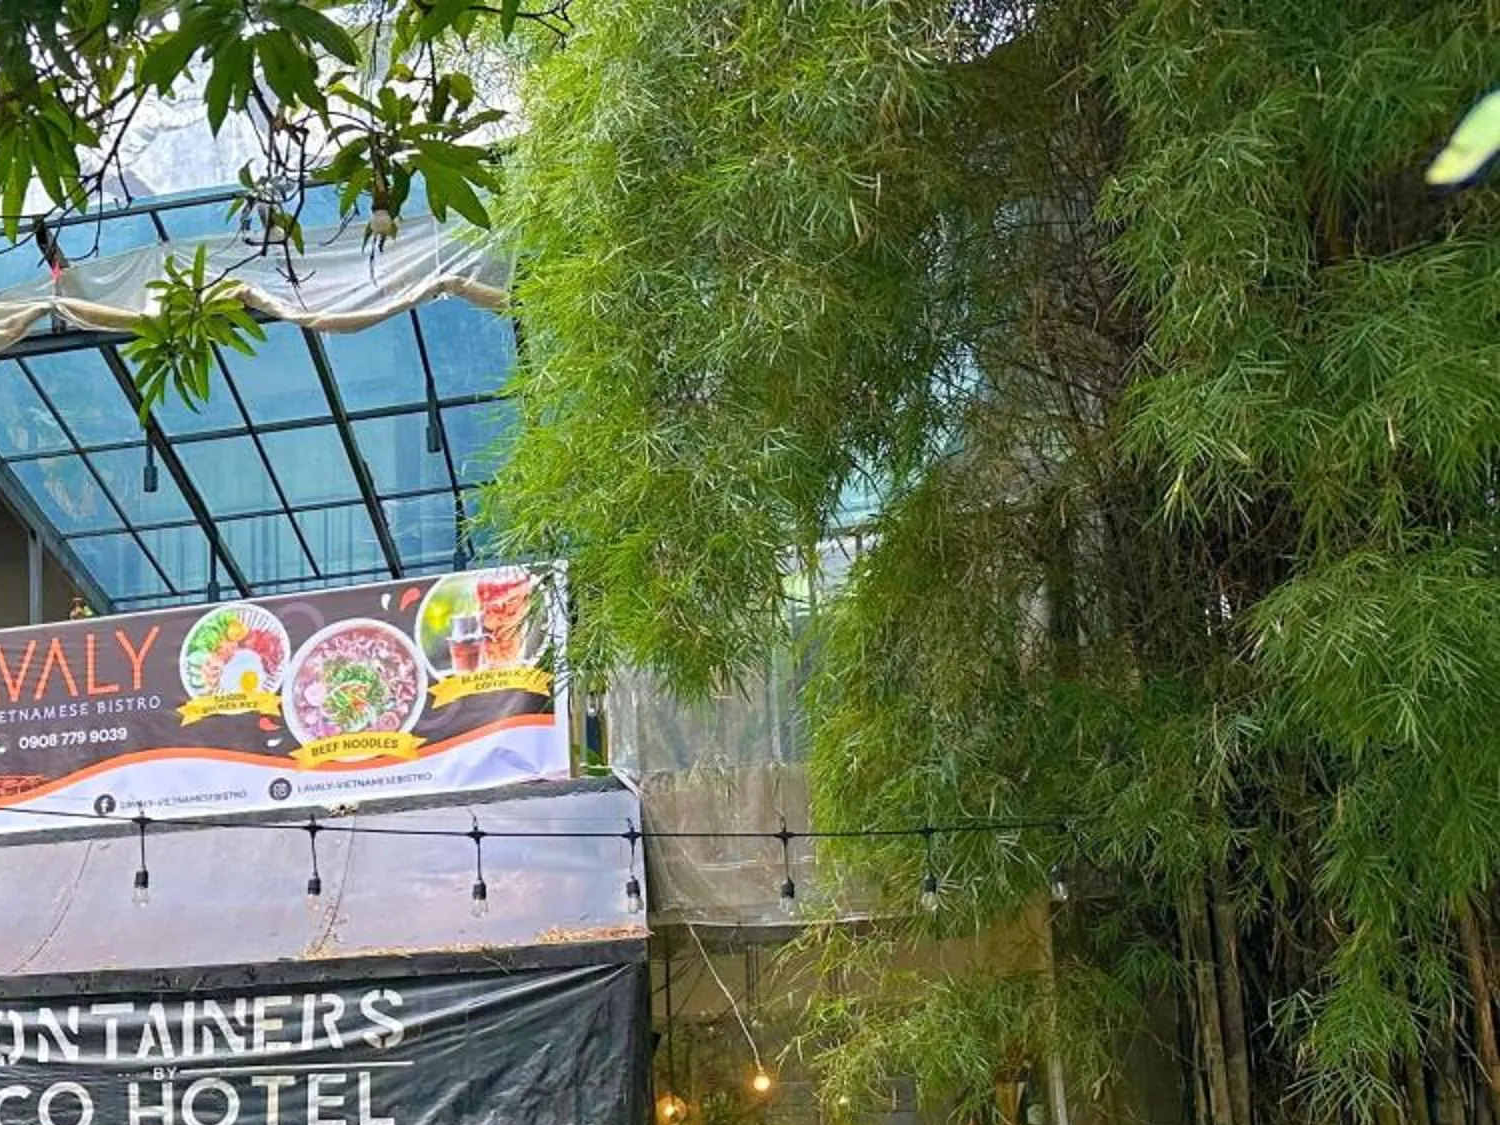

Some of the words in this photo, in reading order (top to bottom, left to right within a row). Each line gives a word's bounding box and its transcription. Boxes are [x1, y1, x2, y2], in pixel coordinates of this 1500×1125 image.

[97, 695, 162, 714] BISTRO
[19, 734, 57, 750] 0908
[61, 732, 87, 747] 779
[89, 727, 127, 745] 9039
[311, 742, 339, 757] BEEF
[343, 737, 399, 750] NOODLES
[152, 1066, 178, 1081] BY
